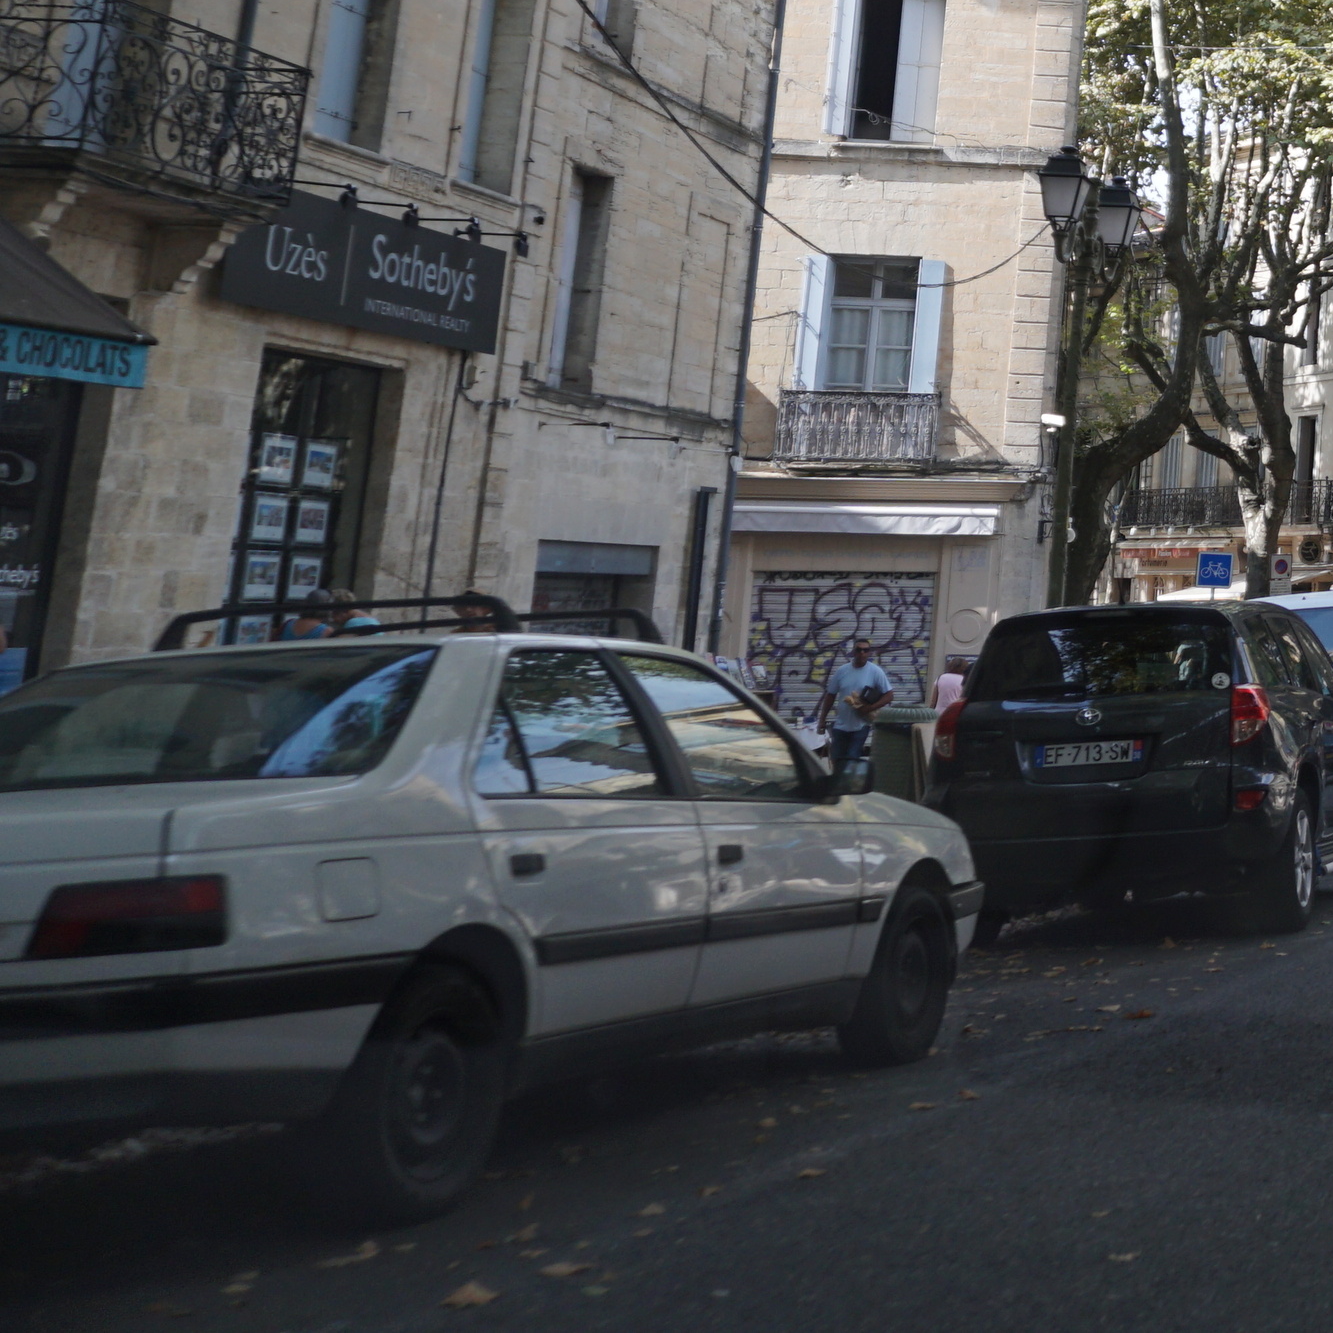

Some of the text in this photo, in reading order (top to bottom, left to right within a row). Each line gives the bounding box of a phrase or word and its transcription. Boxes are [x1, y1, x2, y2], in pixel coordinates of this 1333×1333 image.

[265, 224, 328, 281] Uzès
[368, 234, 476, 311] Sotheby's
[363, 298, 471, 333] INTERNATIONAL REALTY
[16, 330, 131, 377] CHOCOLATS
[1044, 743, 1131, 765] EF-713-SW
